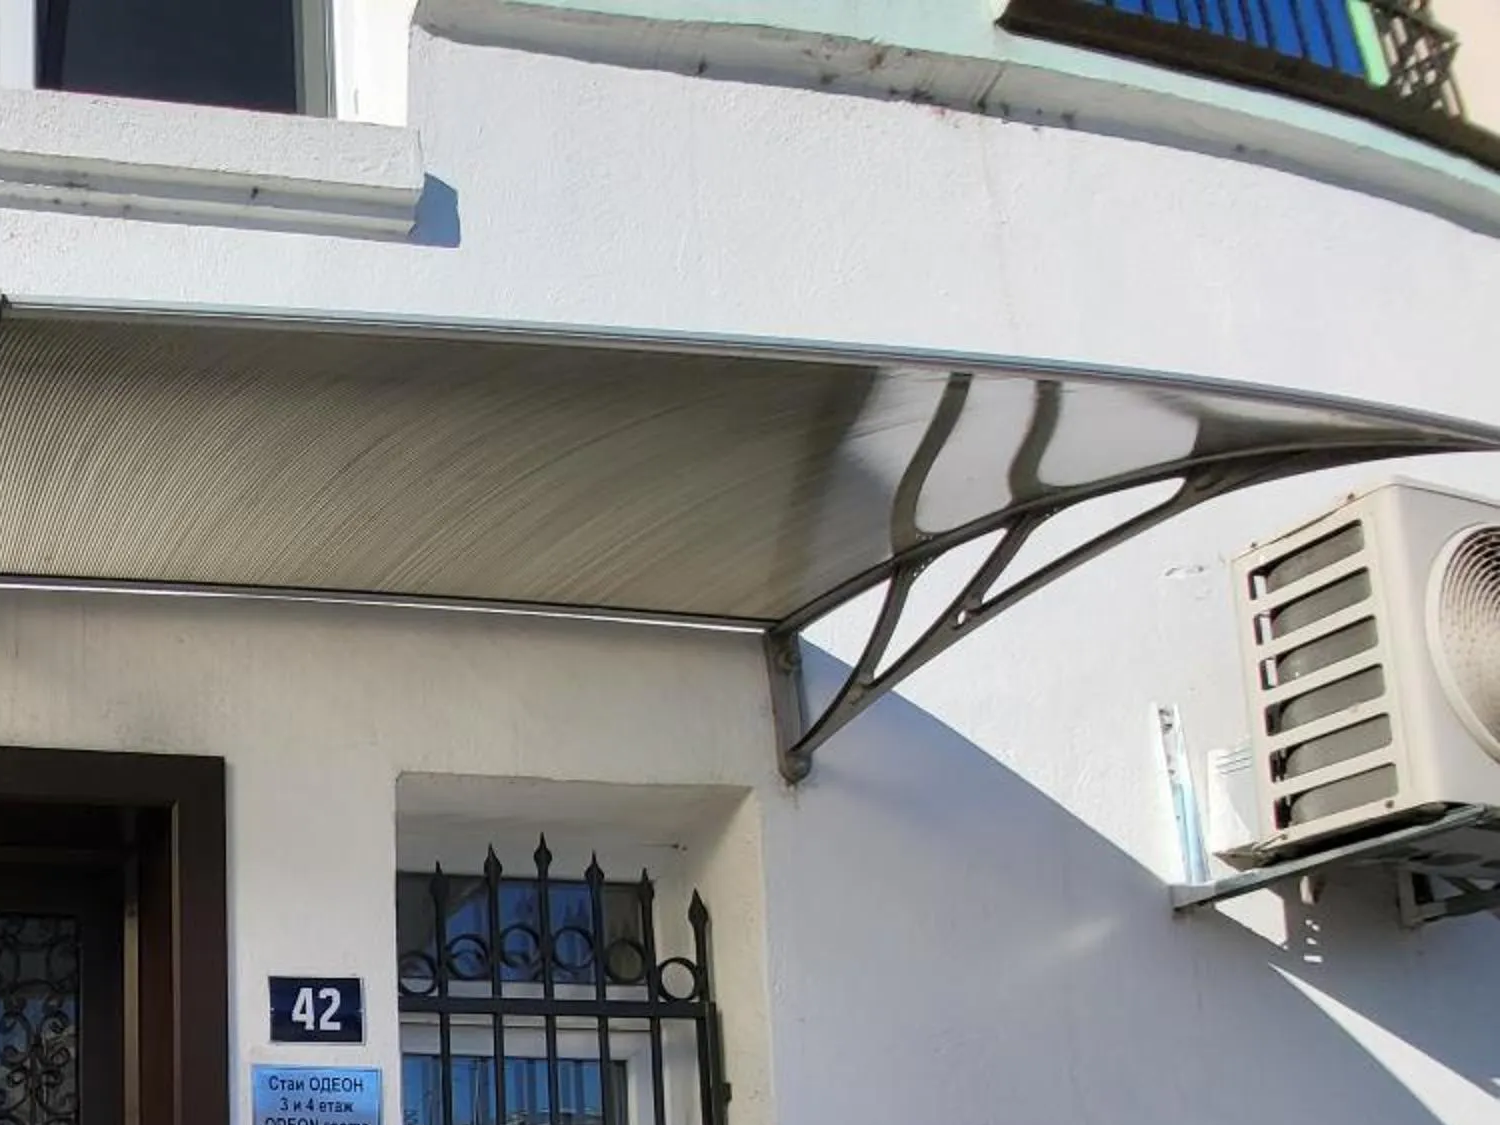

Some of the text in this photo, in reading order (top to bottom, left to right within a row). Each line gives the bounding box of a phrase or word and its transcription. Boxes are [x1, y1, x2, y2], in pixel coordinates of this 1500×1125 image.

[291, 987, 341, 1031] 42
[268, 1075, 364, 1093] Стаи ОДЕОН
[280, 1097, 354, 1113] 3 и 4 етаж
